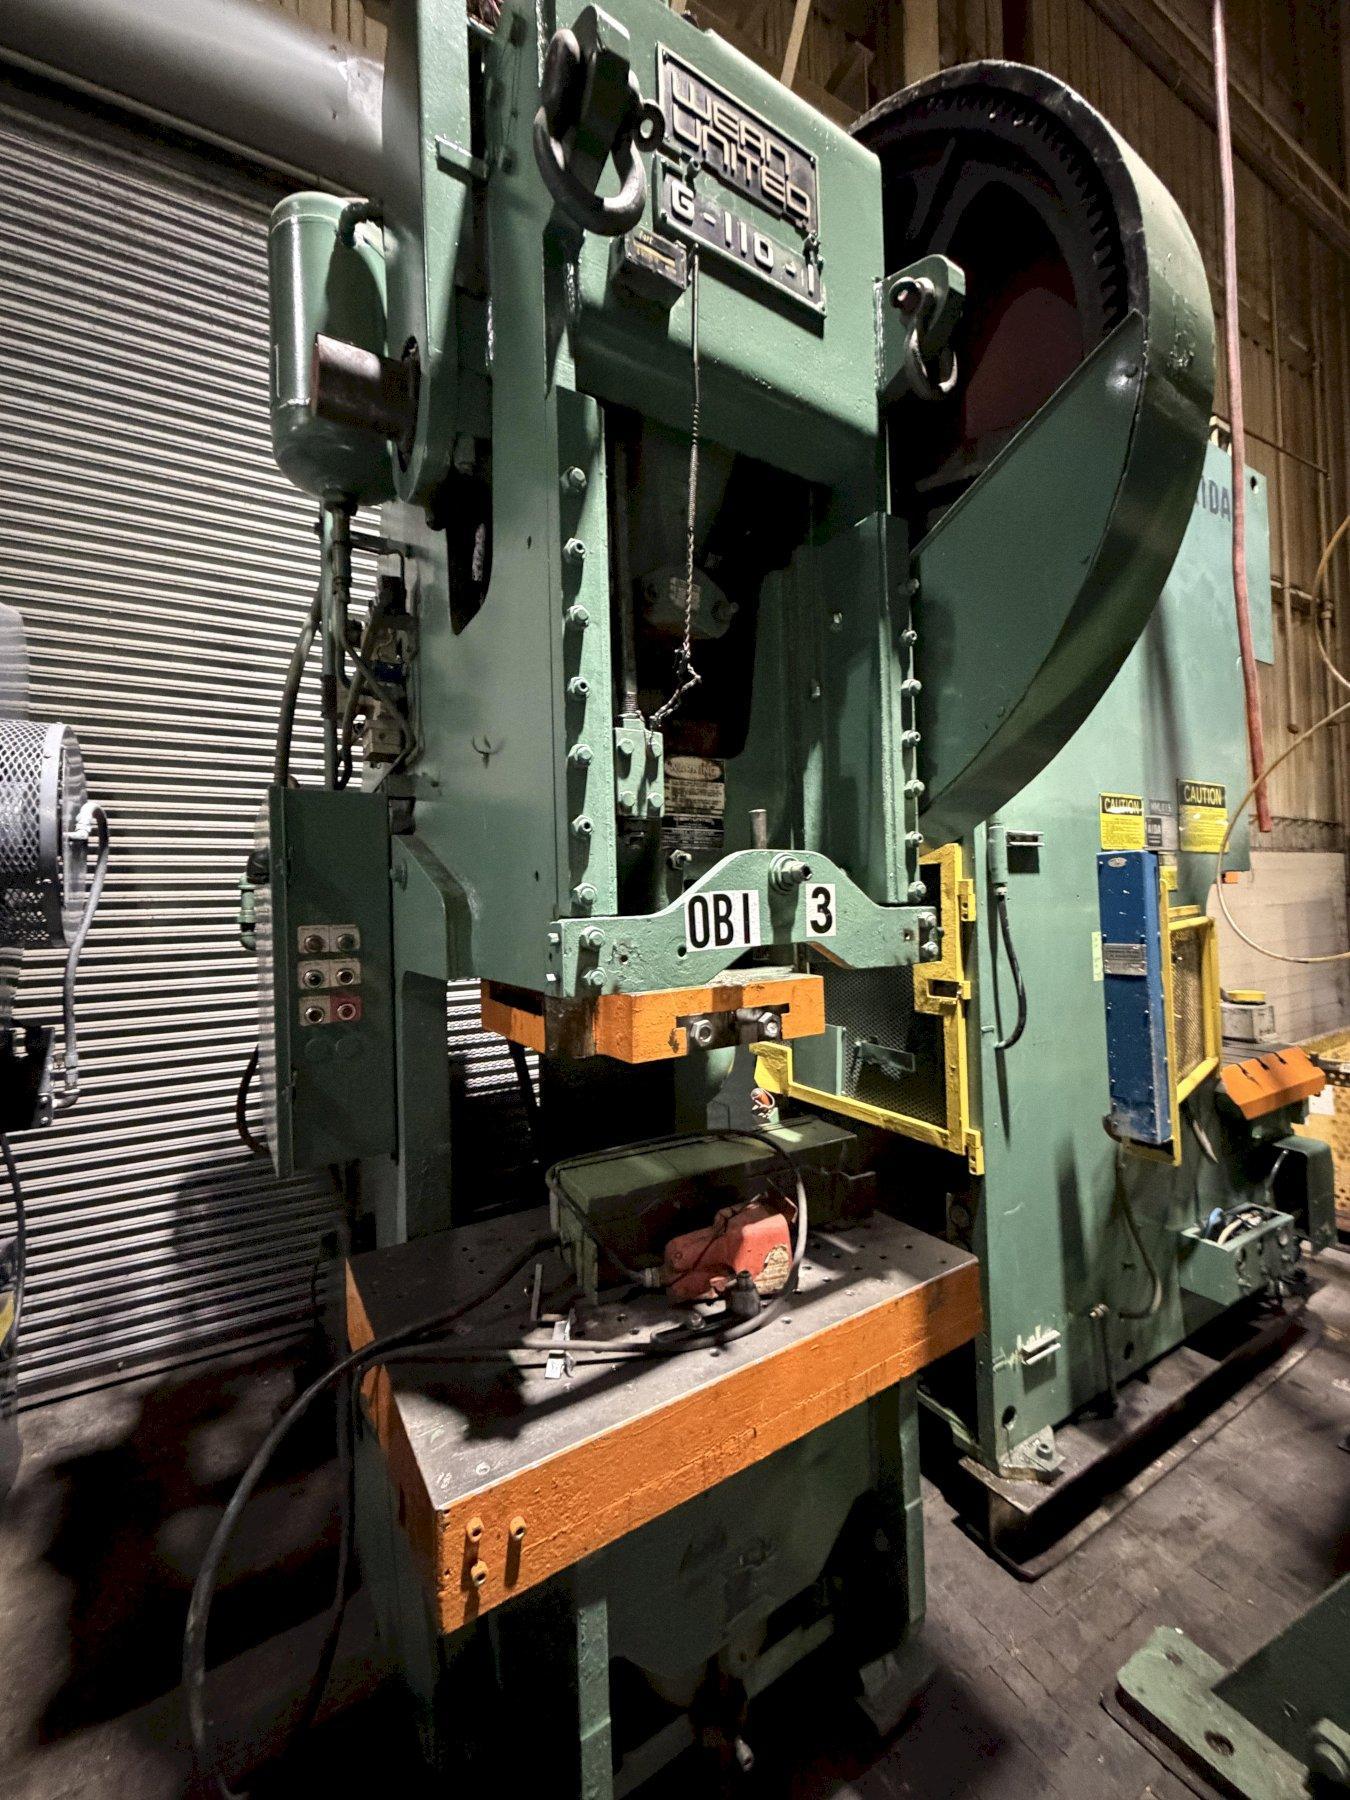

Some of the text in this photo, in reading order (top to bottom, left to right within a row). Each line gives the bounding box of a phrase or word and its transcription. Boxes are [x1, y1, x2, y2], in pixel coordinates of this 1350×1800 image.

[671, 70, 791, 180] WEAN
[671, 102, 811, 221] UNITED
[1194, 478, 1231, 522] IDA
[1104, 798, 1140, 814] CAUTION
[1184, 785, 1222, 805] CAUTION
[688, 893, 751, 949] OBI
[810, 886, 833, 934] 3
